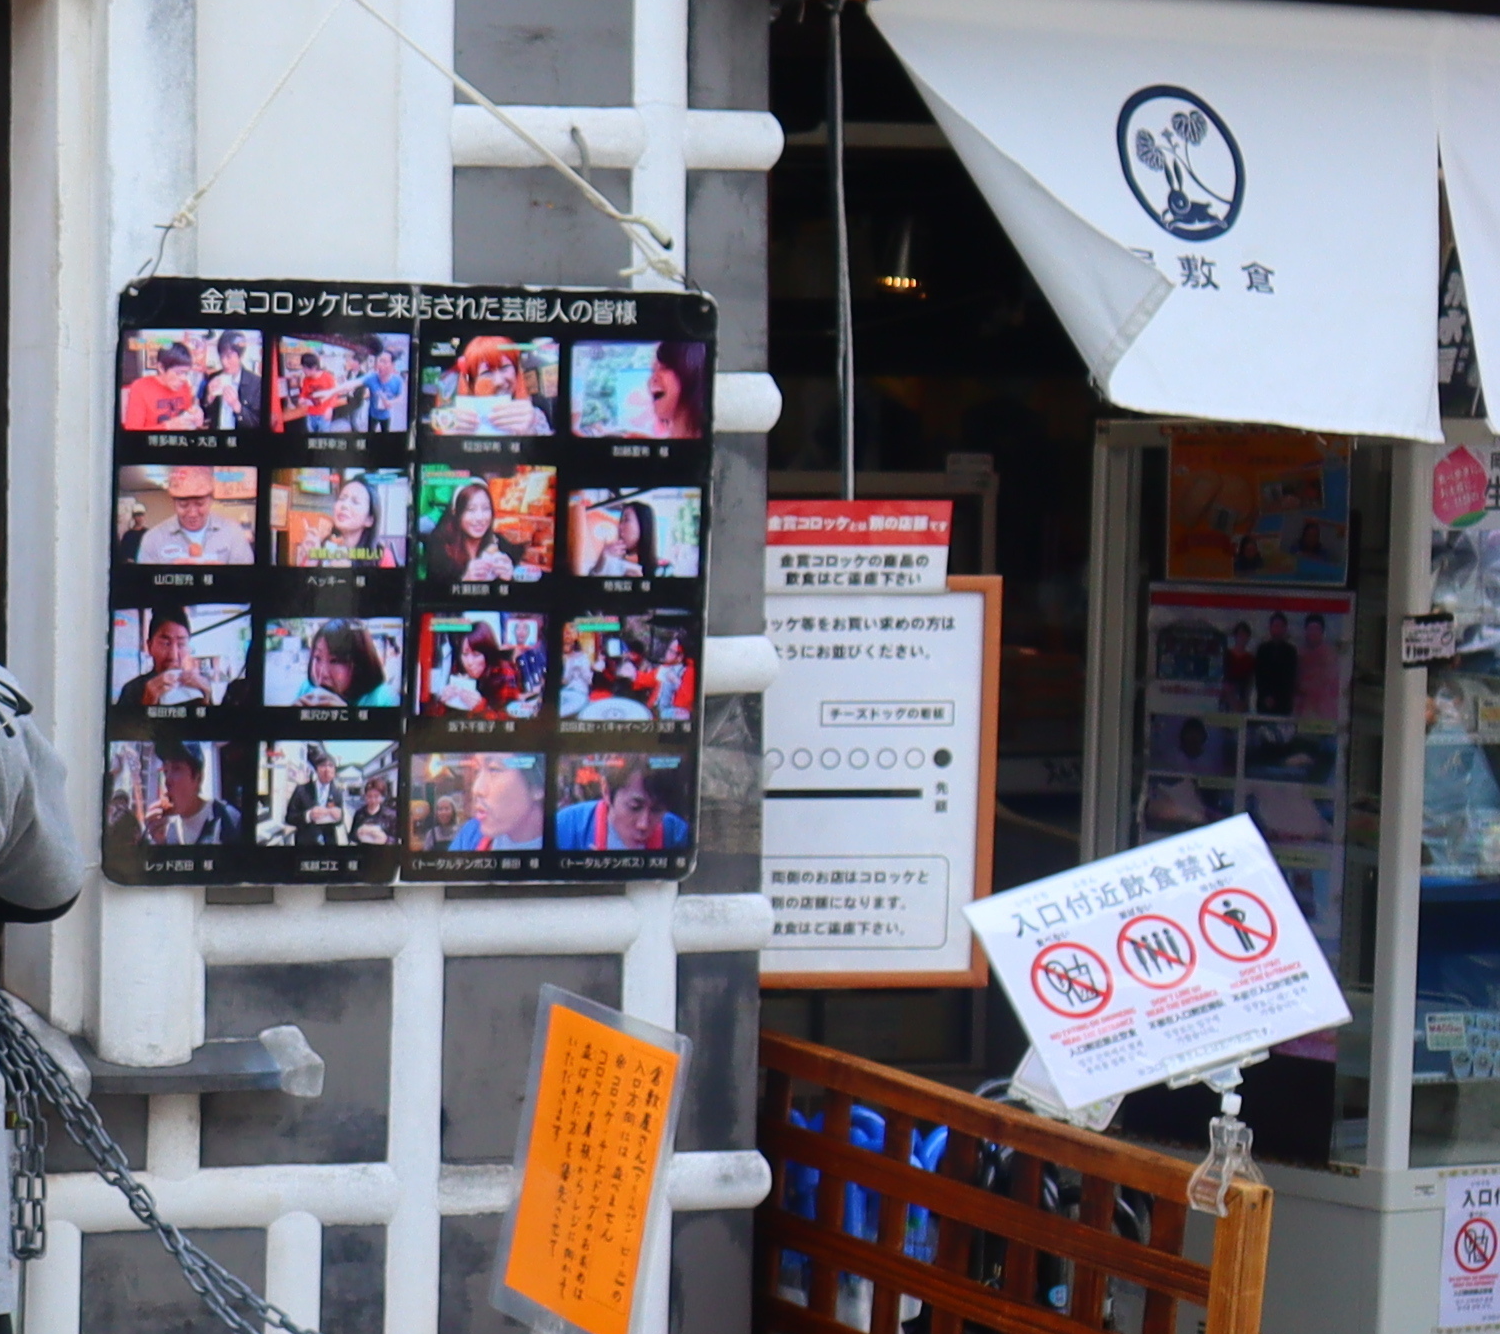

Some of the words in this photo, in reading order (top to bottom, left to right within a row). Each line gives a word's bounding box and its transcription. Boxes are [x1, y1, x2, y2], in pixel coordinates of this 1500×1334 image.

[198, 288, 639, 327] 金賞コロッケにご来店された芸能人の皆様
[770, 616, 956, 632] ッケ等をお買い求めの方は
[1011, 846, 1236, 938] 入口付近飲食禁止
